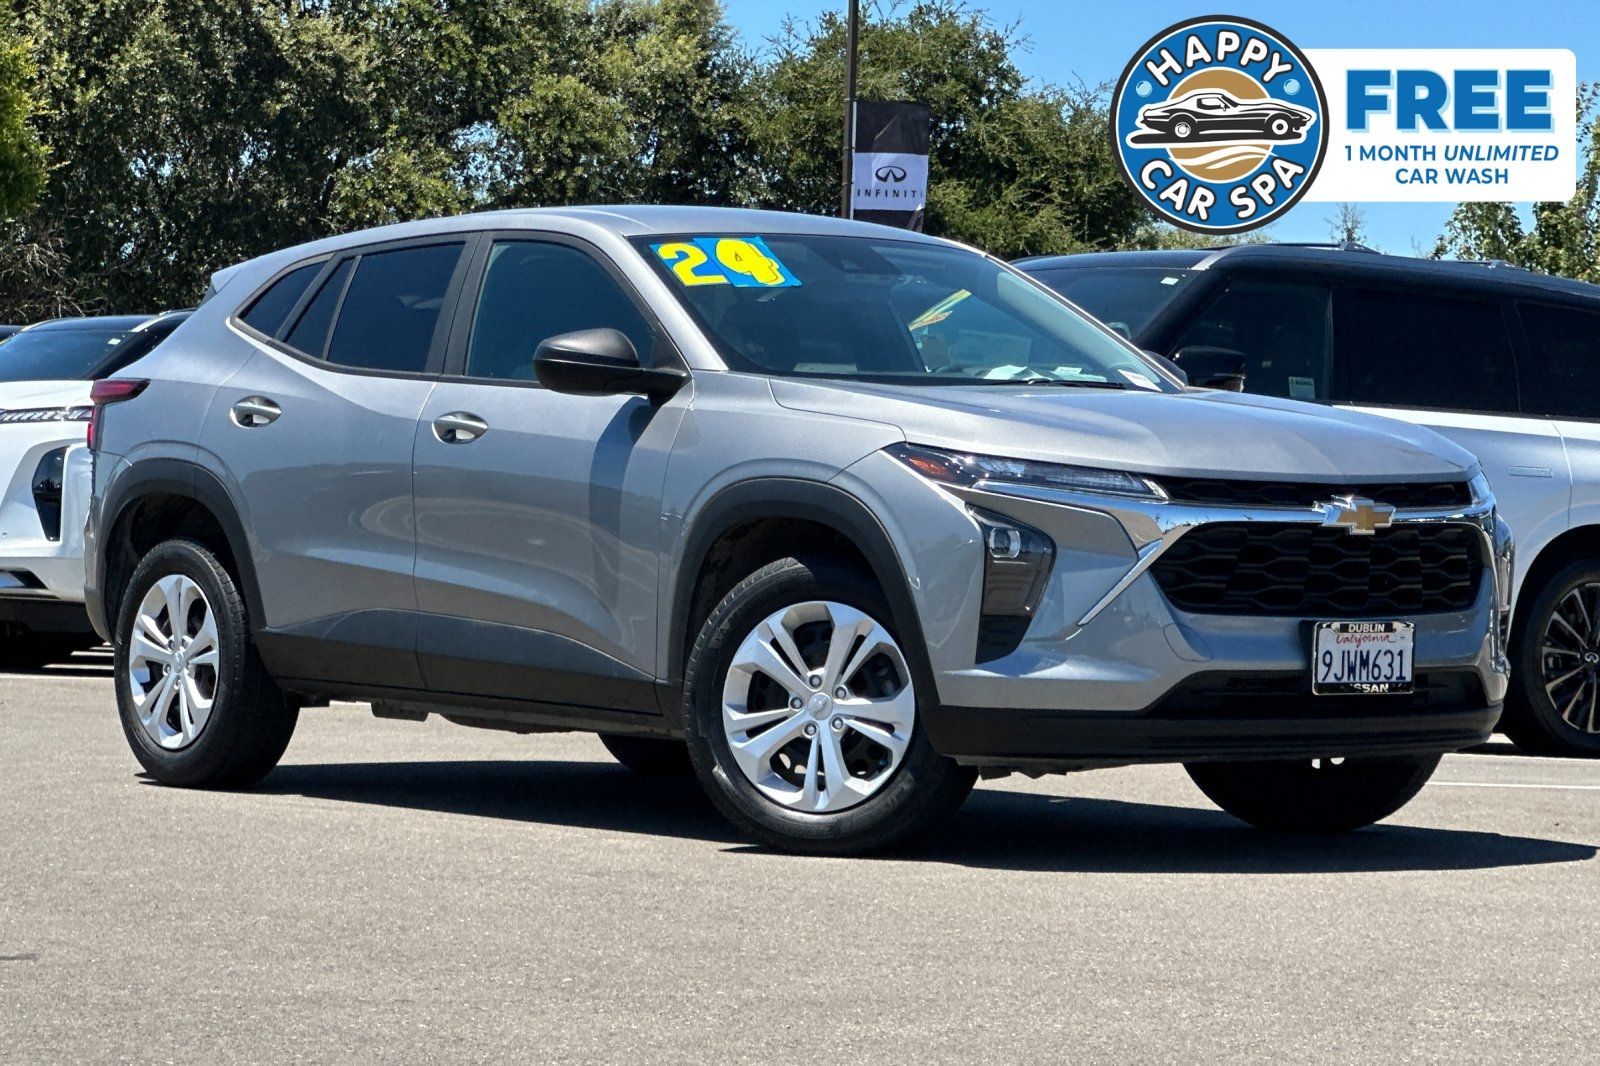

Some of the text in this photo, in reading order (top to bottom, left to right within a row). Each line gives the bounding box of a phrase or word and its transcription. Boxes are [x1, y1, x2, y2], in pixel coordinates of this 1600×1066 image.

[857, 189, 923, 198] INFINITI
[657, 239, 785, 286] 24
[1348, 623, 1385, 633] DUBLIN
[1336, 633, 1397, 648] California
[1321, 649, 1406, 682] 9JWM631
